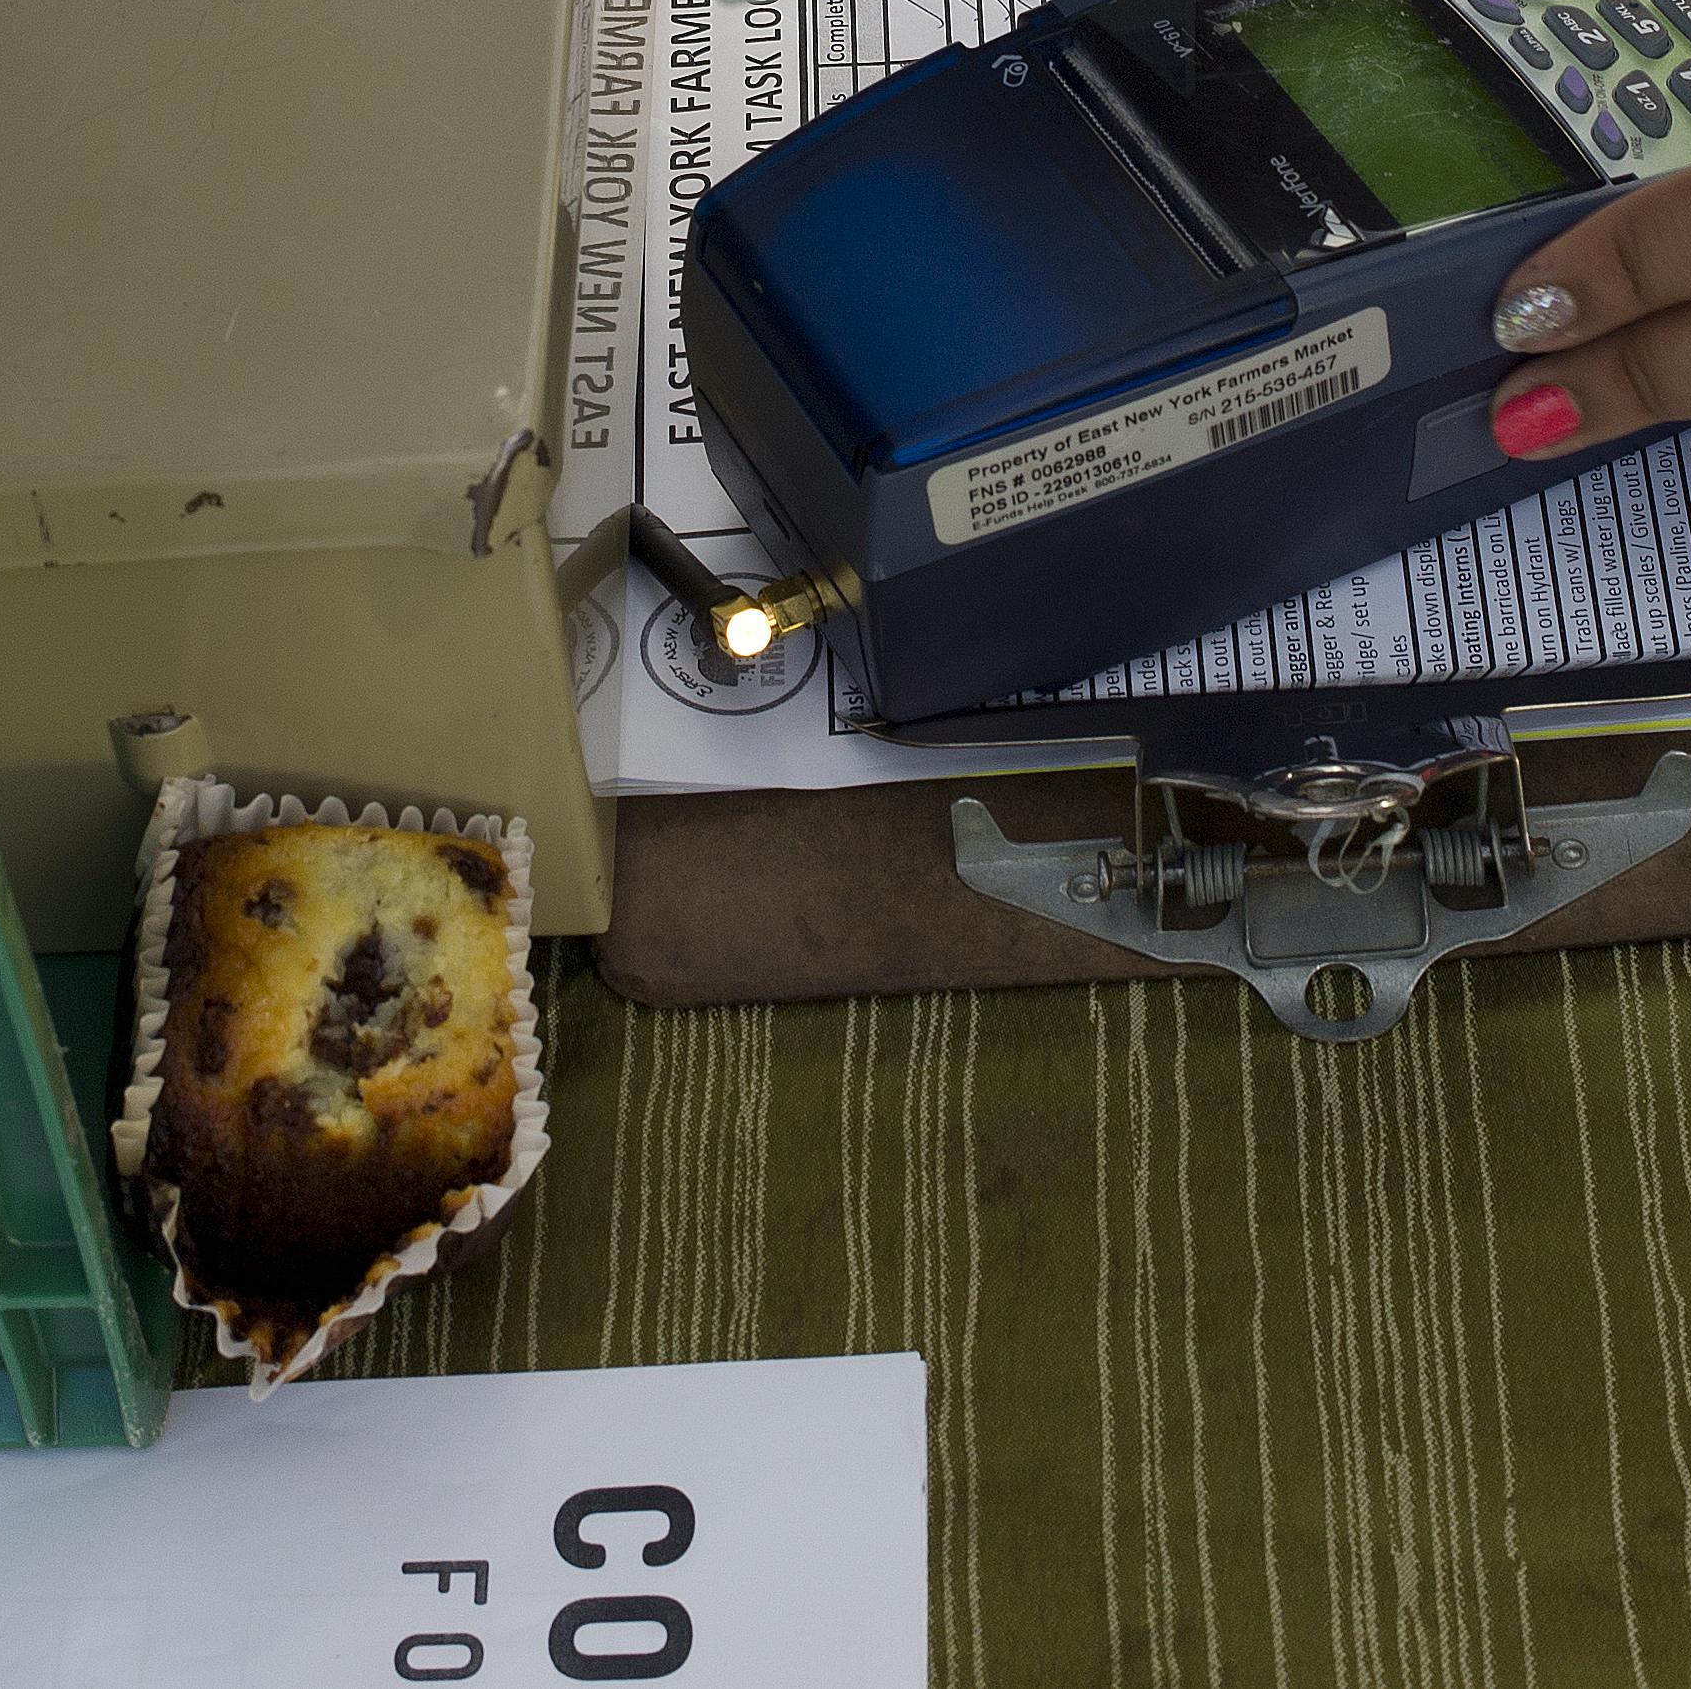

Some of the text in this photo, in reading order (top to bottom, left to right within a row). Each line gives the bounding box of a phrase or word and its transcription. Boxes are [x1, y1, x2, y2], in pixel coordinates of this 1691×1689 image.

[1557, 11, 1583, 33] ABC
[1614, 3, 1638, 23] JKL
[744, 51, 784, 132] TASK
[668, 121, 712, 227] YORK
[1269, 154, 1326, 219] VeriFone
[967, 326, 1356, 484] Property of East New York Farmers Market
[1187, 353, 1339, 428] S/N 215-536-457
[968, 479, 1010, 505] FNS
[1655, 444, 1677, 475] Joy,
[969, 496, 1011, 521] POS
[971, 484, 1090, 532] E-Funds Help Desk
[1662, 478, 1681, 517] Love
[1454, 545, 1479, 607] Interns
[1523, 535, 1553, 605] Hydrant
[1557, 498, 1595, 655] Trash cans bags
[1591, 494, 1627, 618] filled water jug
[1625, 474, 1670, 631] up scales Give out
[1350, 574, 1371, 629] set up
[1422, 592, 1443, 640] down
[1488, 565, 1517, 639] barricade
[547, 1482, 697, 1683] CO
